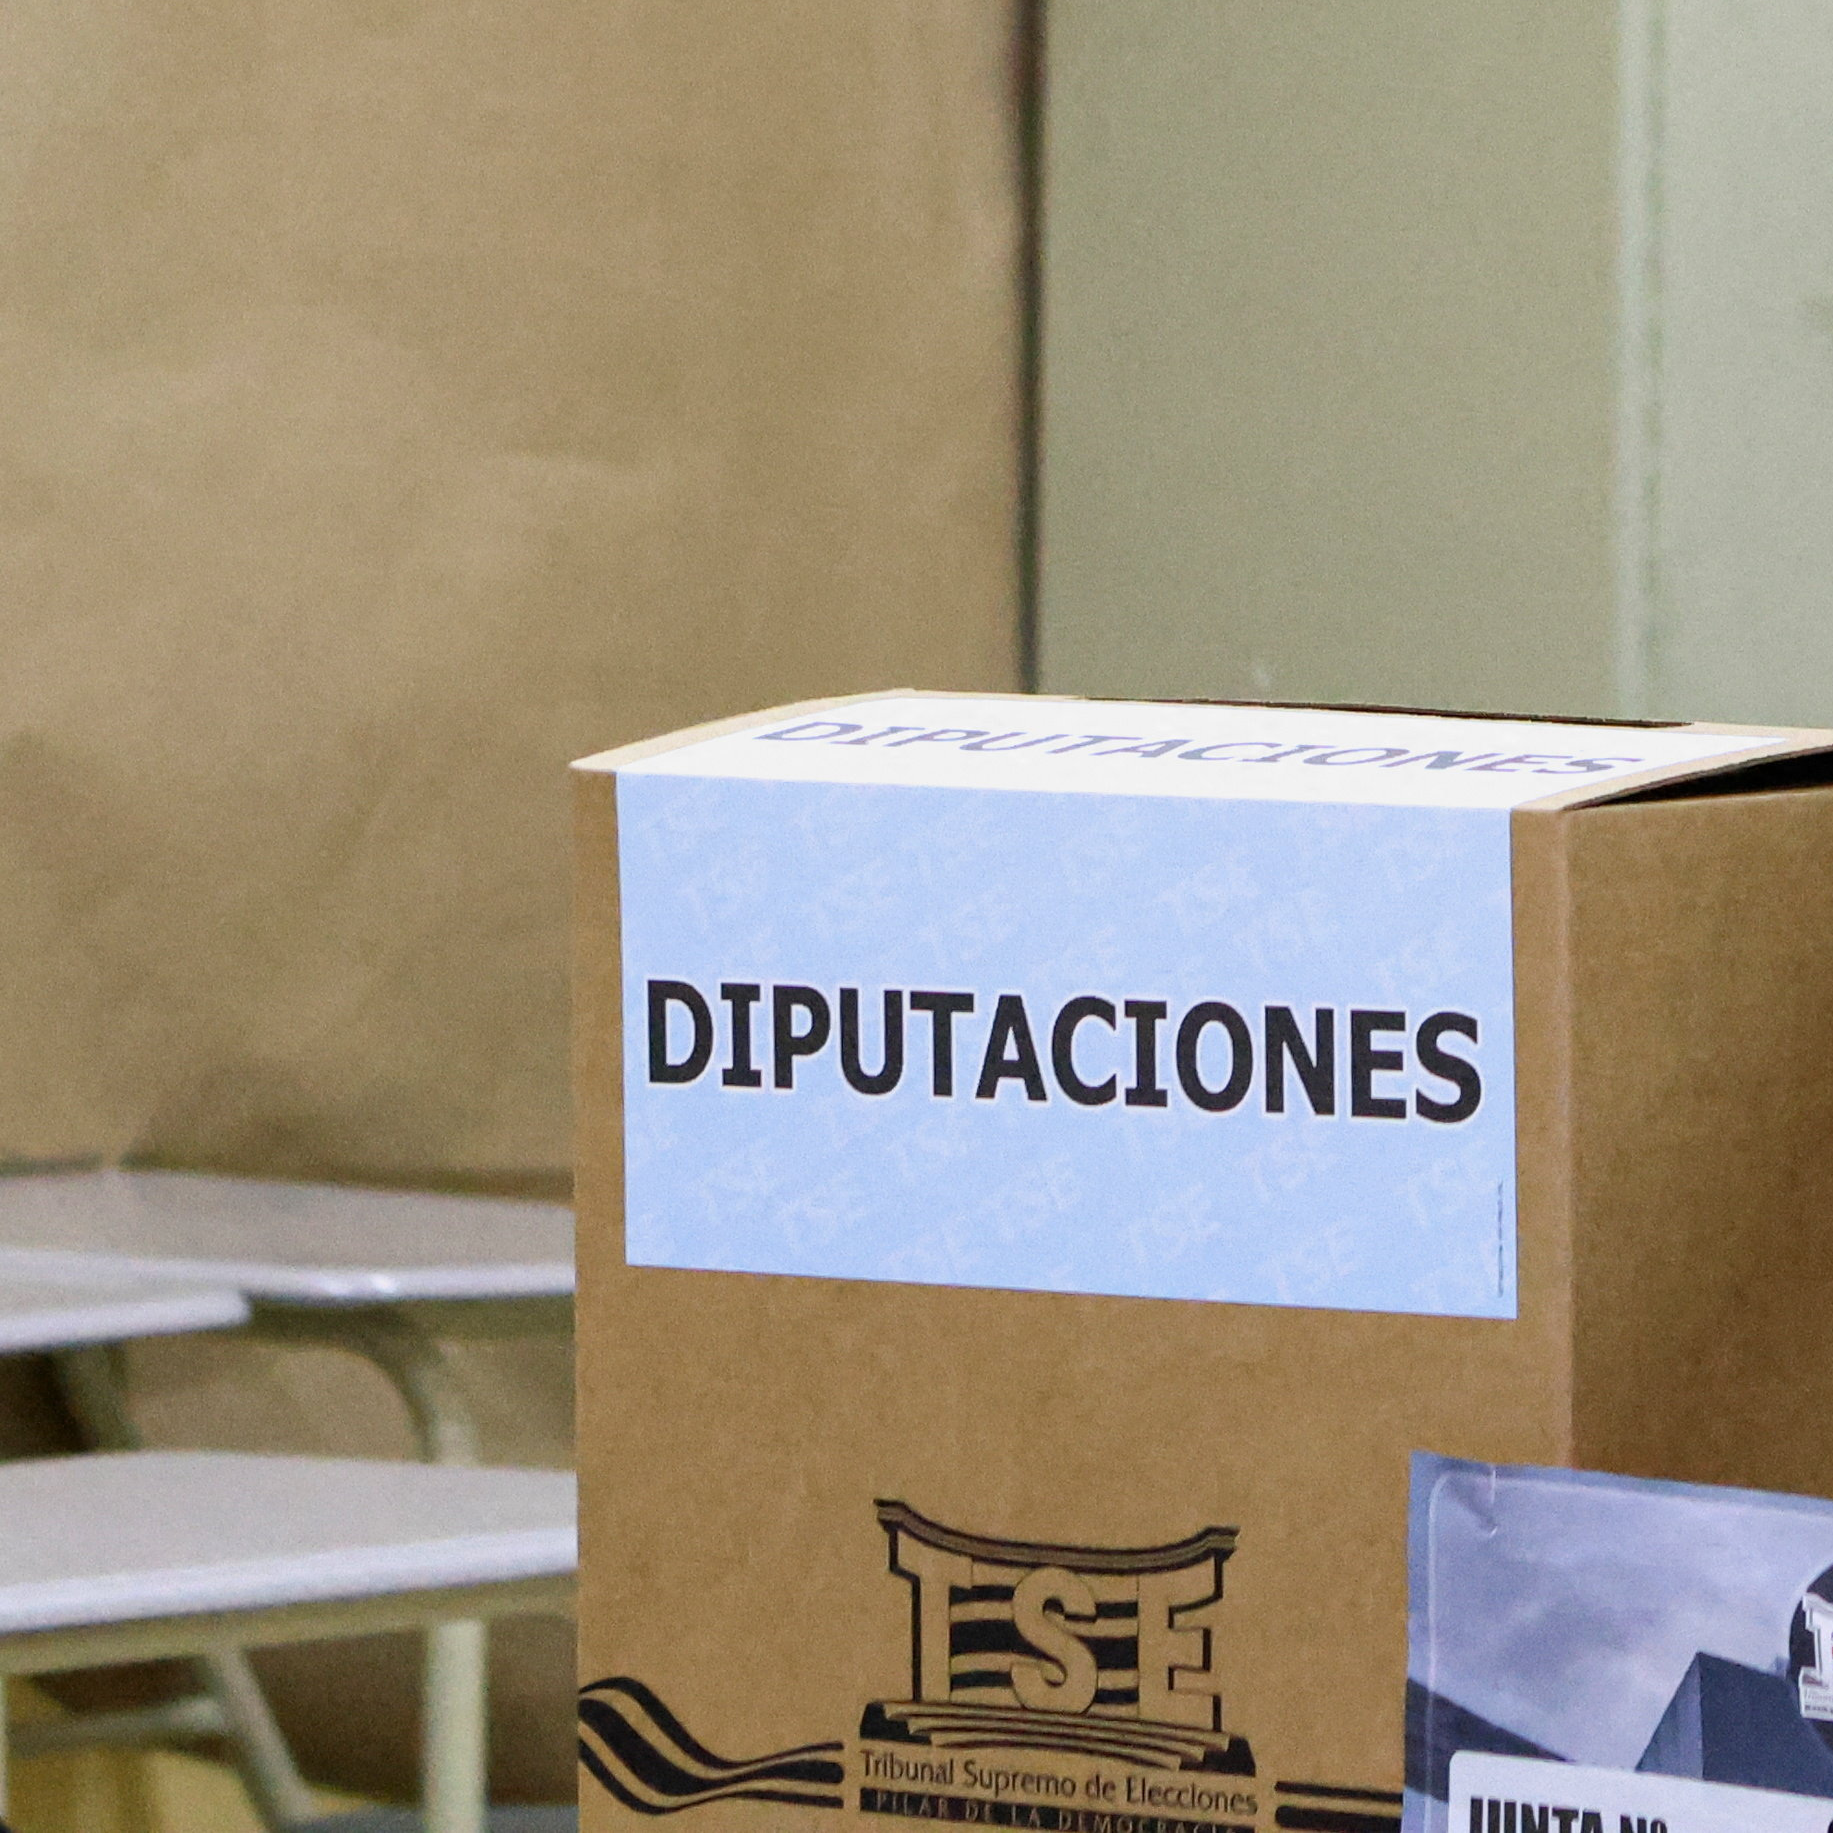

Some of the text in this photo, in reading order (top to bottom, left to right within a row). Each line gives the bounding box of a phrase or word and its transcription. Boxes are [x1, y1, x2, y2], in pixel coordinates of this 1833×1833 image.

[753, 719, 1641, 777] DIPUTACIONES
[646, 979, 1483, 1123] DIPUTACIONES
[886, 1522, 1223, 1734] TSE
[860, 1748, 1259, 1816] Tribunal Supremo de Elecciones
[876, 1789, 950, 1819] PILAR
